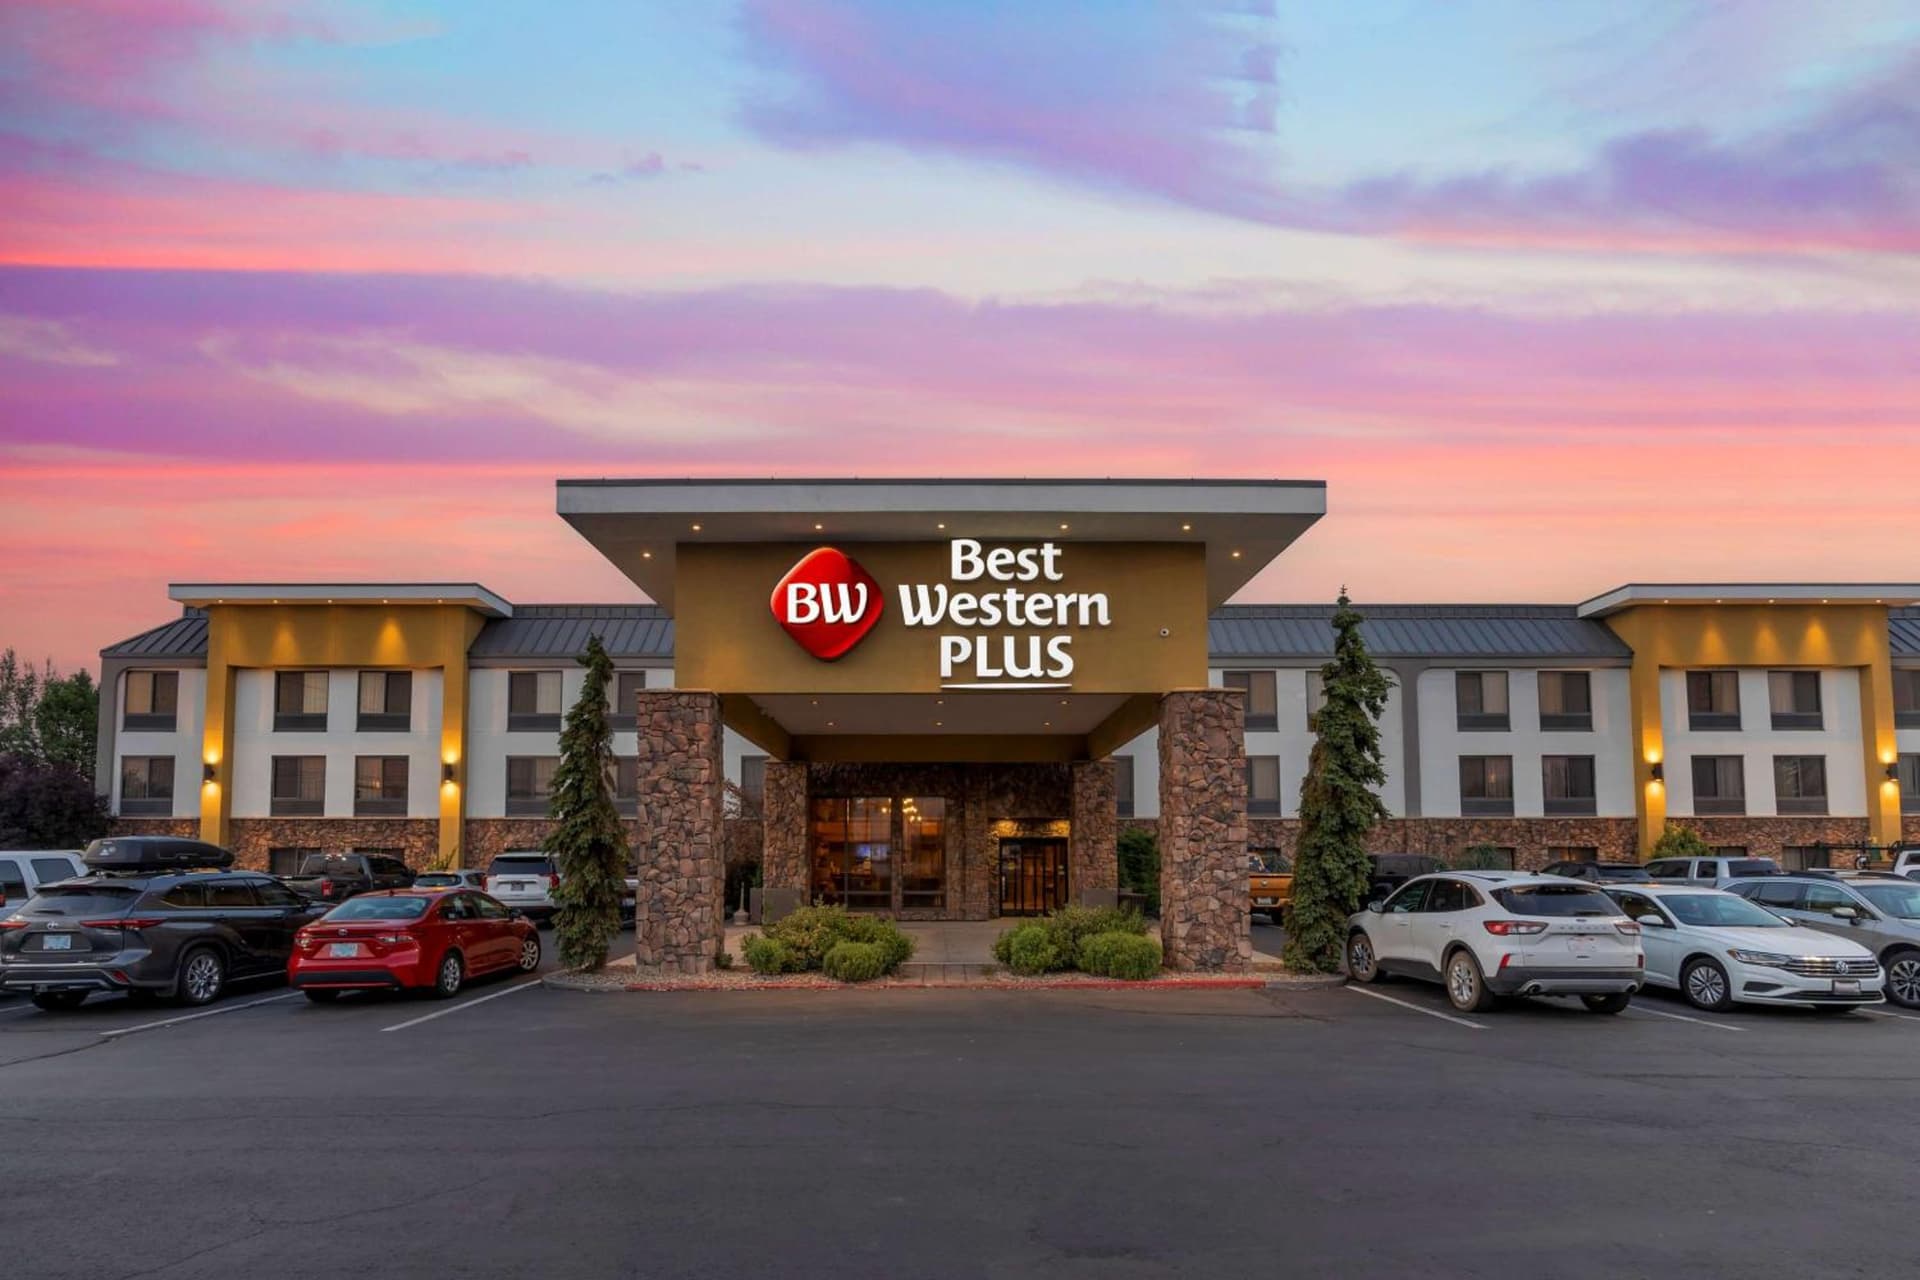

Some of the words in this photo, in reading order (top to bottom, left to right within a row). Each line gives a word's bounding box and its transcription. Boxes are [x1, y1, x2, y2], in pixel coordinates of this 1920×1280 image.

[951, 539, 1063, 581] Best
[787, 582, 867, 624] BW
[898, 583, 1111, 626] Western
[940, 635, 1074, 678] PLUS
